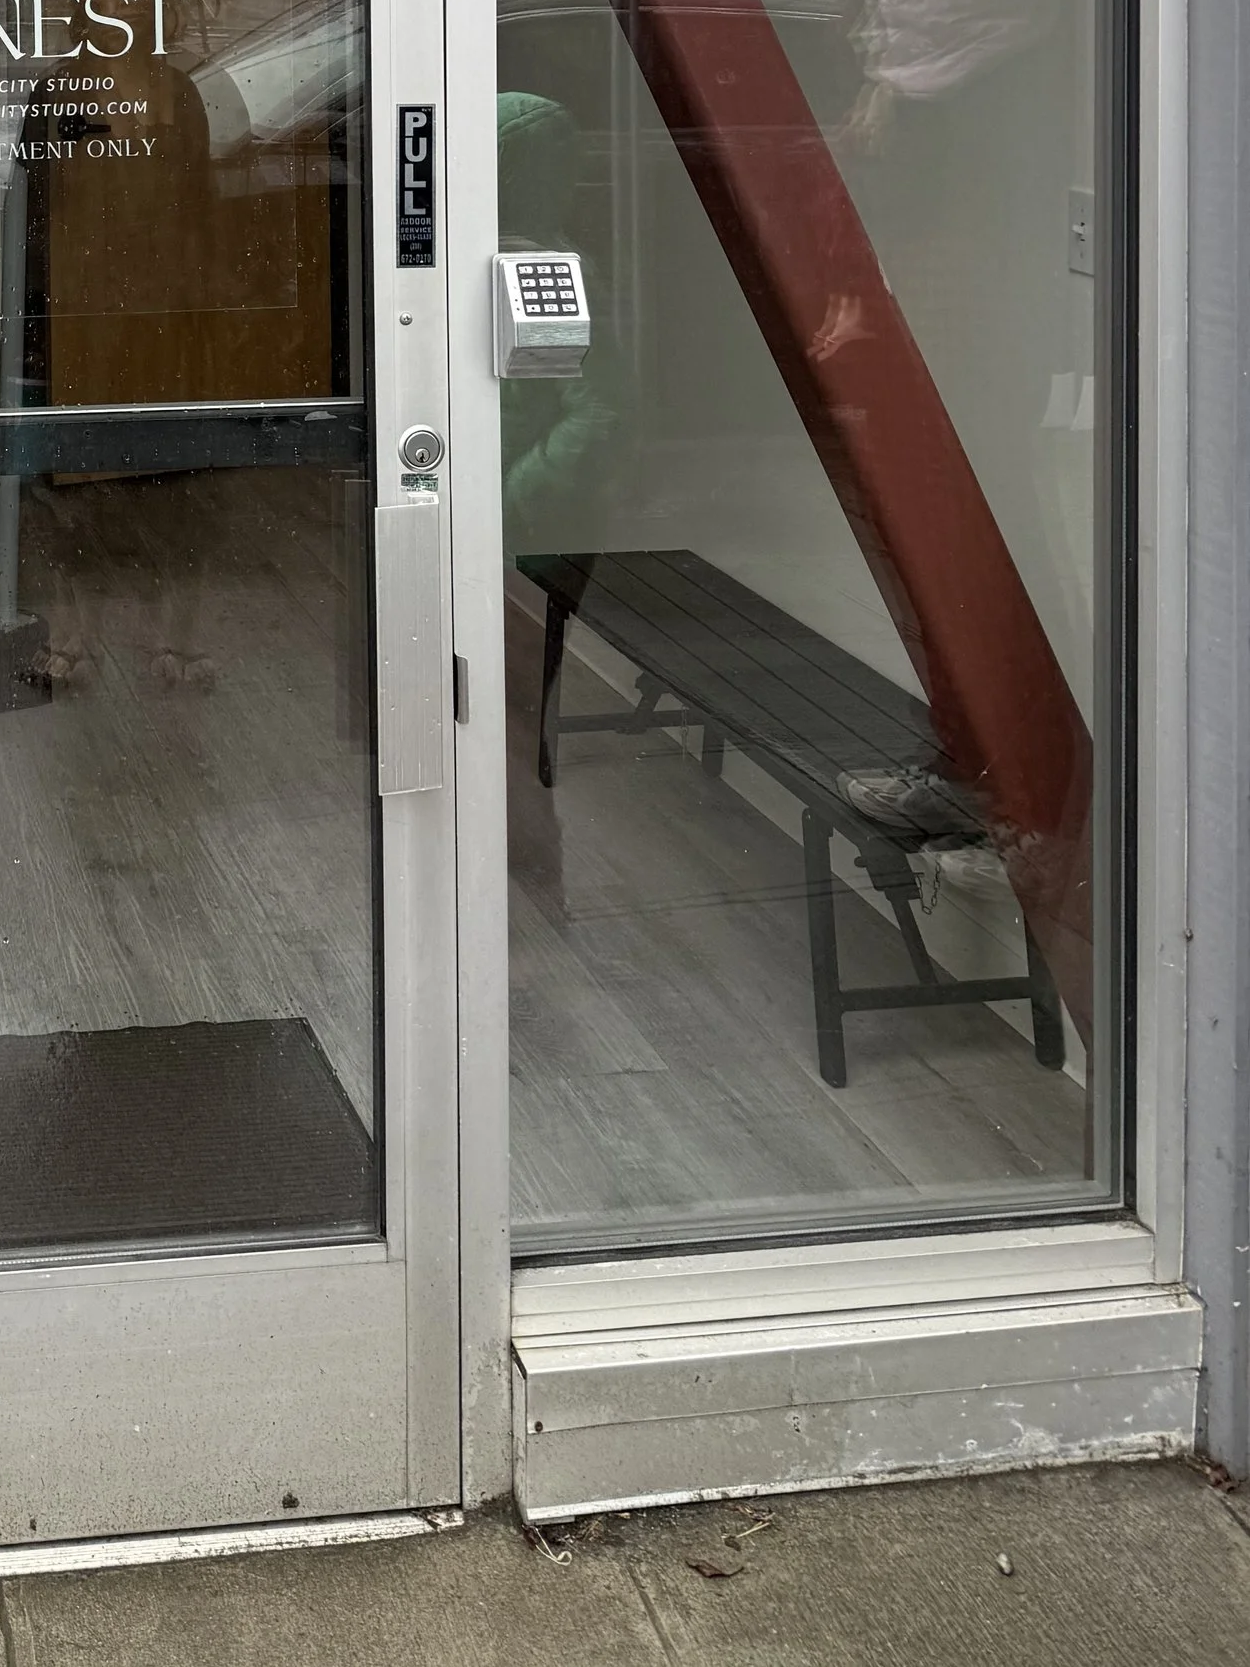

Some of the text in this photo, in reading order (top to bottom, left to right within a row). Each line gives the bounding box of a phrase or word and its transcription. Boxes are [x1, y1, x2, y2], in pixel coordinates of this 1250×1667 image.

[46, 77, 115, 92] STUDIO
[86, 138, 157, 159] ONLY
[404, 111, 427, 215] PULL
